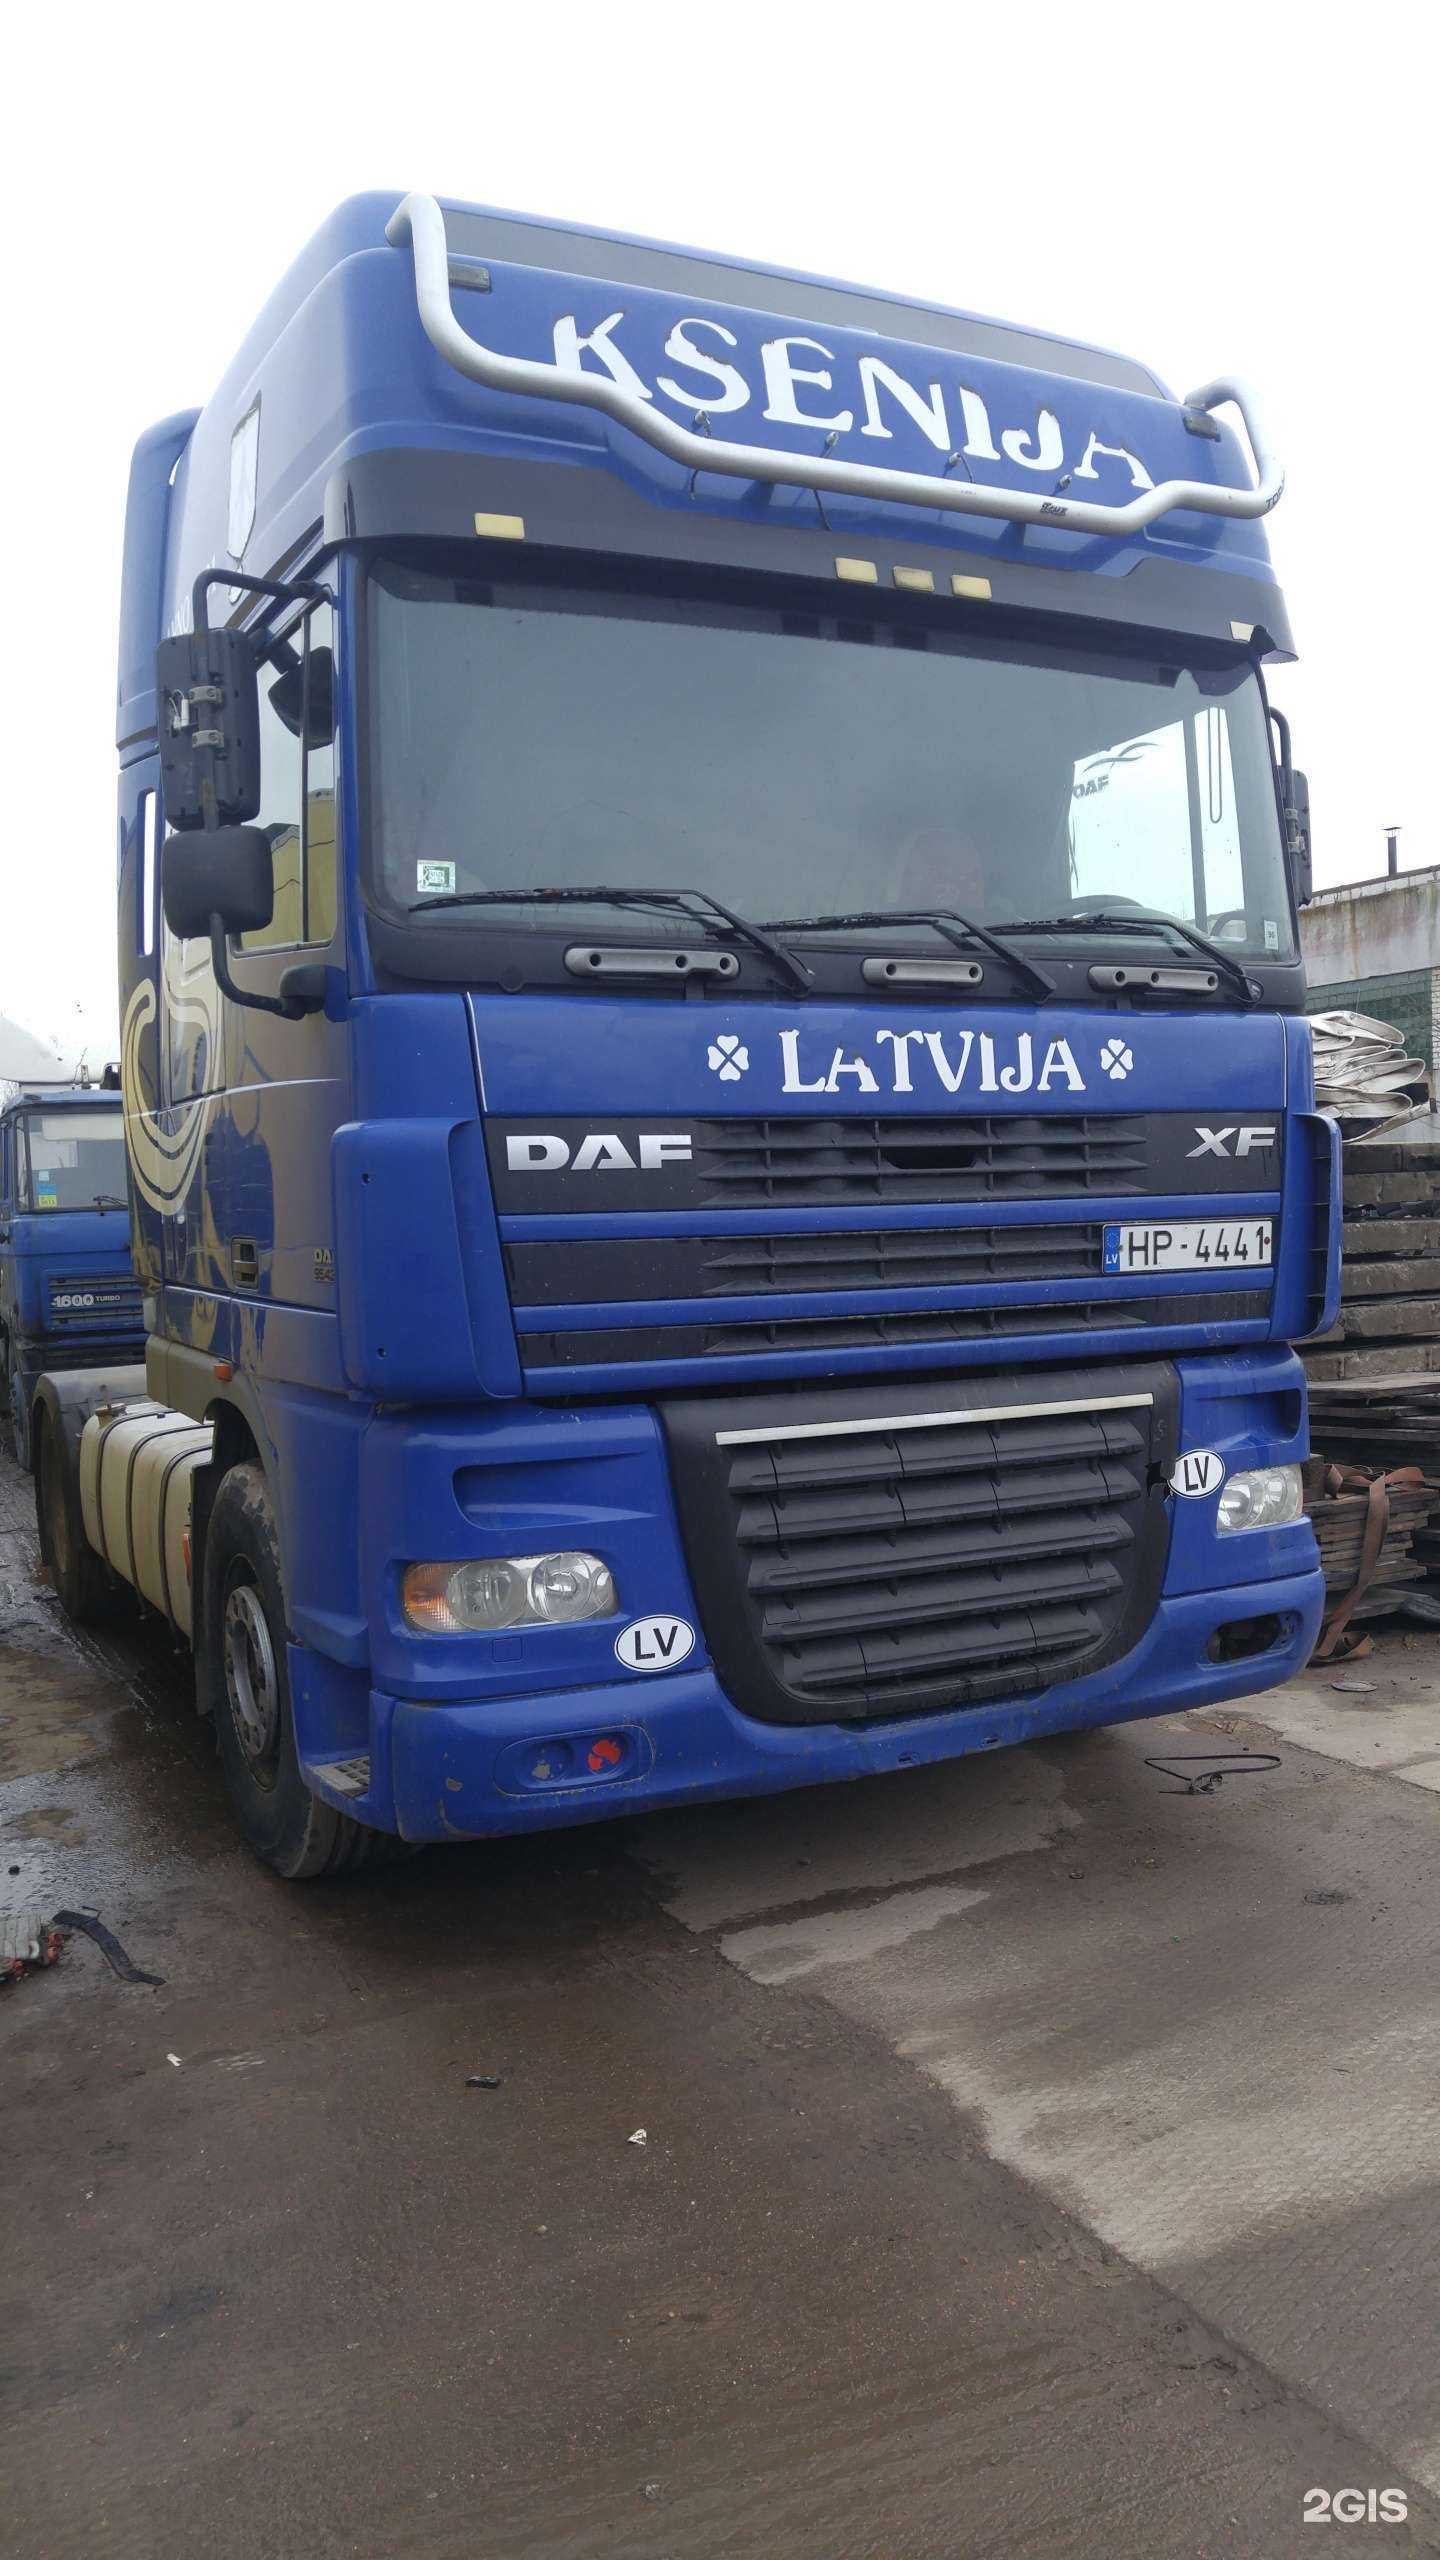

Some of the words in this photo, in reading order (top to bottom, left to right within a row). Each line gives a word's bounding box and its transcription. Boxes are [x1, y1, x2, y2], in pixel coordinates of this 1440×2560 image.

[552, 311, 1156, 490] KSENIJA
[779, 1029, 1086, 1093] LATVIJA
[506, 1133, 692, 1171] DAF
[1184, 1126, 1276, 1157] XF
[1106, 1254, 1119, 1265] LV
[1128, 1225, 1265, 1267] HP-4441
[1184, 1455, 1210, 1492] LV
[633, 1625, 679, 1661] LV
